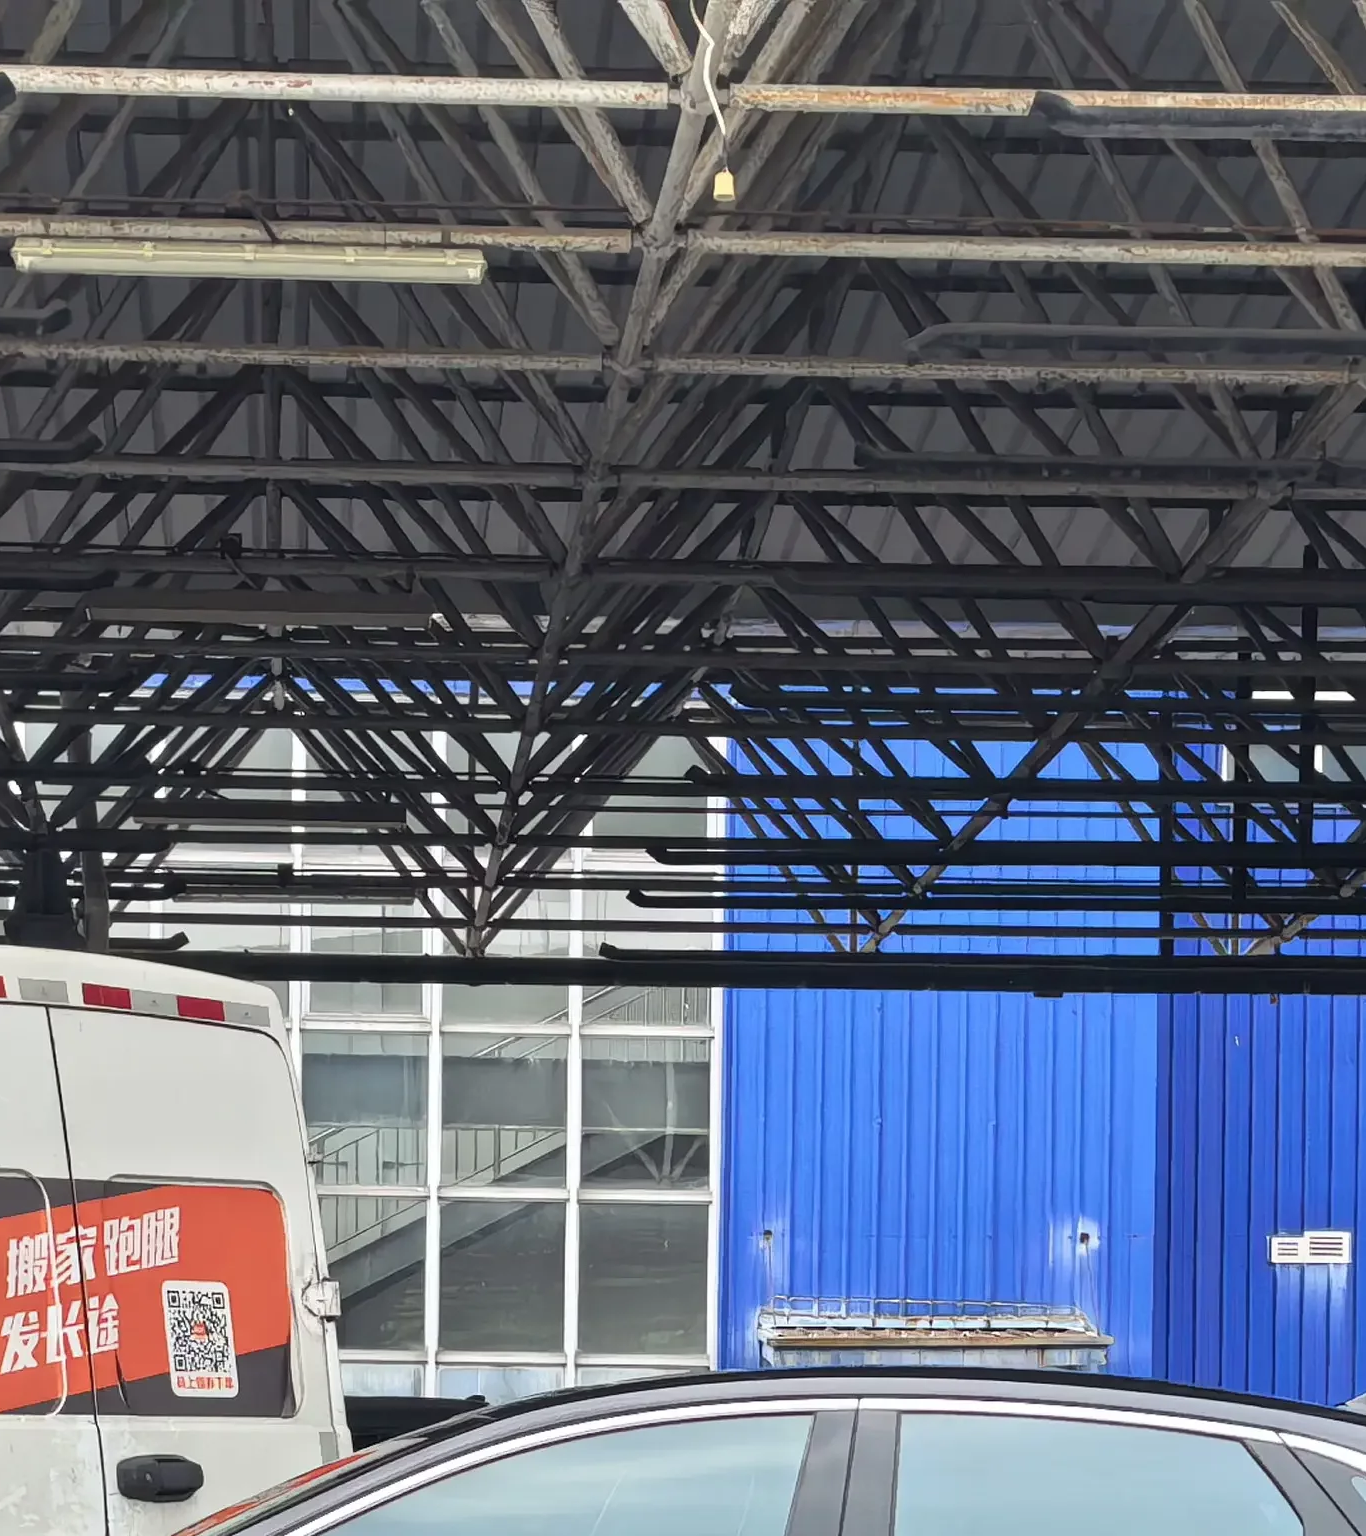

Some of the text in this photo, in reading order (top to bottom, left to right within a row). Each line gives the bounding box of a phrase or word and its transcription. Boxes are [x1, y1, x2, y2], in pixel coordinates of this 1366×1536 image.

[6, 1223, 97, 1299] 搬家
[104, 1206, 180, 1276] 跑腿
[0, 1294, 119, 1376] 发长途
